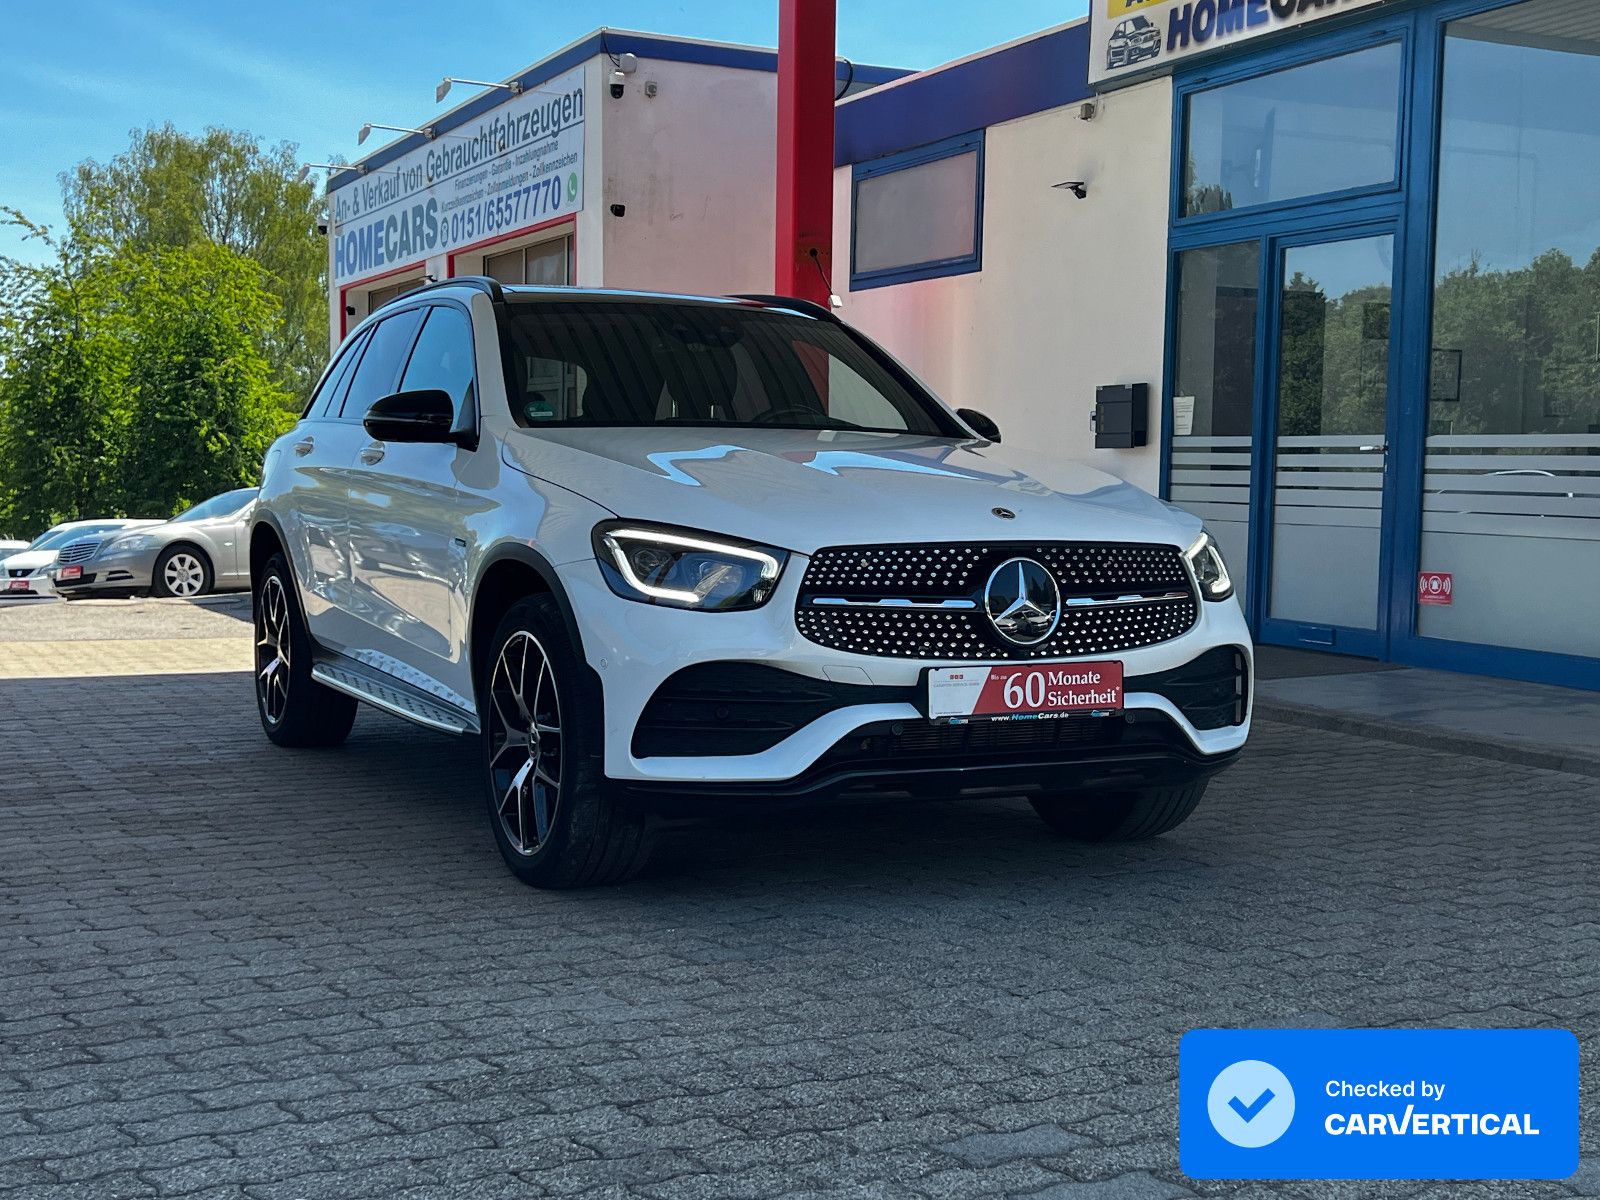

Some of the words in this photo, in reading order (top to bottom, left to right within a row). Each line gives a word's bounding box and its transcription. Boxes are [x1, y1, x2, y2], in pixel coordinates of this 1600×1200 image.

[335, 195, 351, 224] An-
[353, 187, 361, 216] &
[362, 166, 400, 211] Verkauf
[403, 167, 423, 196] von
[426, 87, 583, 183] Gebrauchtfahrzeugen
[335, 197, 439, 280] HOMECARS
[451, 175, 562, 244] 0151/65577770
[1003, 672, 1046, 709] 60
[1048, 670, 1101, 686] Monate
